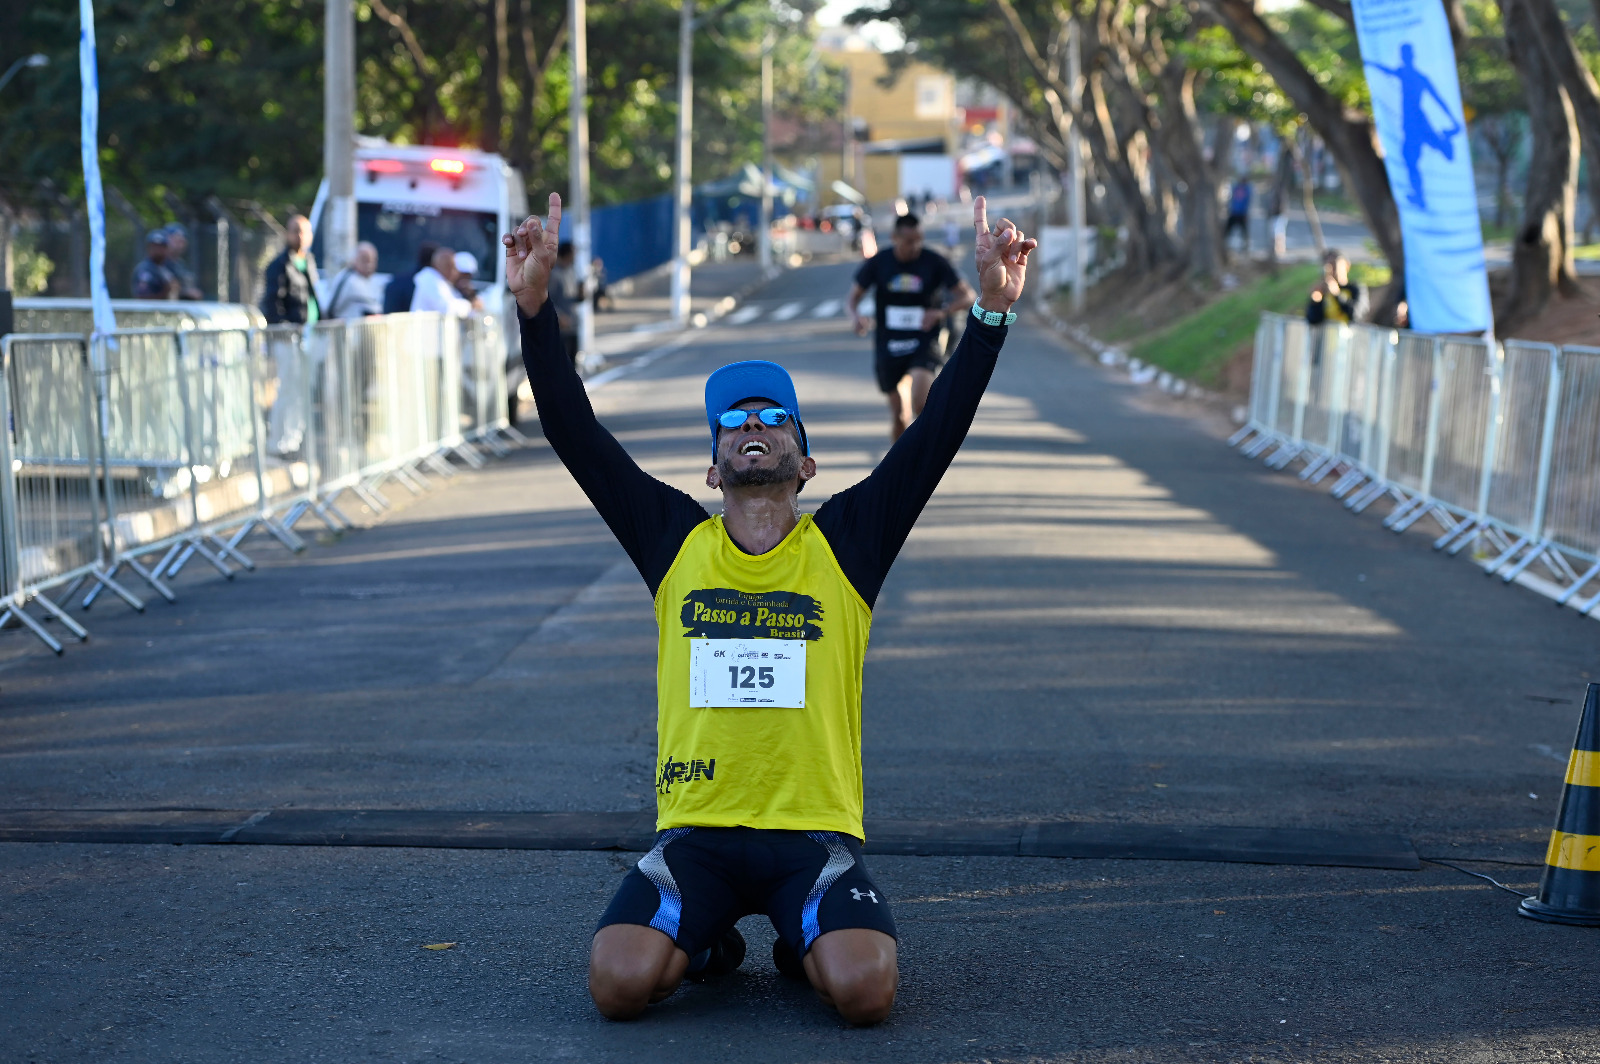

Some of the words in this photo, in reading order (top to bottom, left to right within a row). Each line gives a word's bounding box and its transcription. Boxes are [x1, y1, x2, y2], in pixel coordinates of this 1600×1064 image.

[747, 600, 789, 608] Caminhada
[692, 602, 737, 624] Passo
[740, 612, 751, 626] a
[754, 607, 805, 628] Passo
[770, 628, 806, 638] Brasil
[713, 650, 726, 658] 6K
[728, 665, 775, 689] 125
